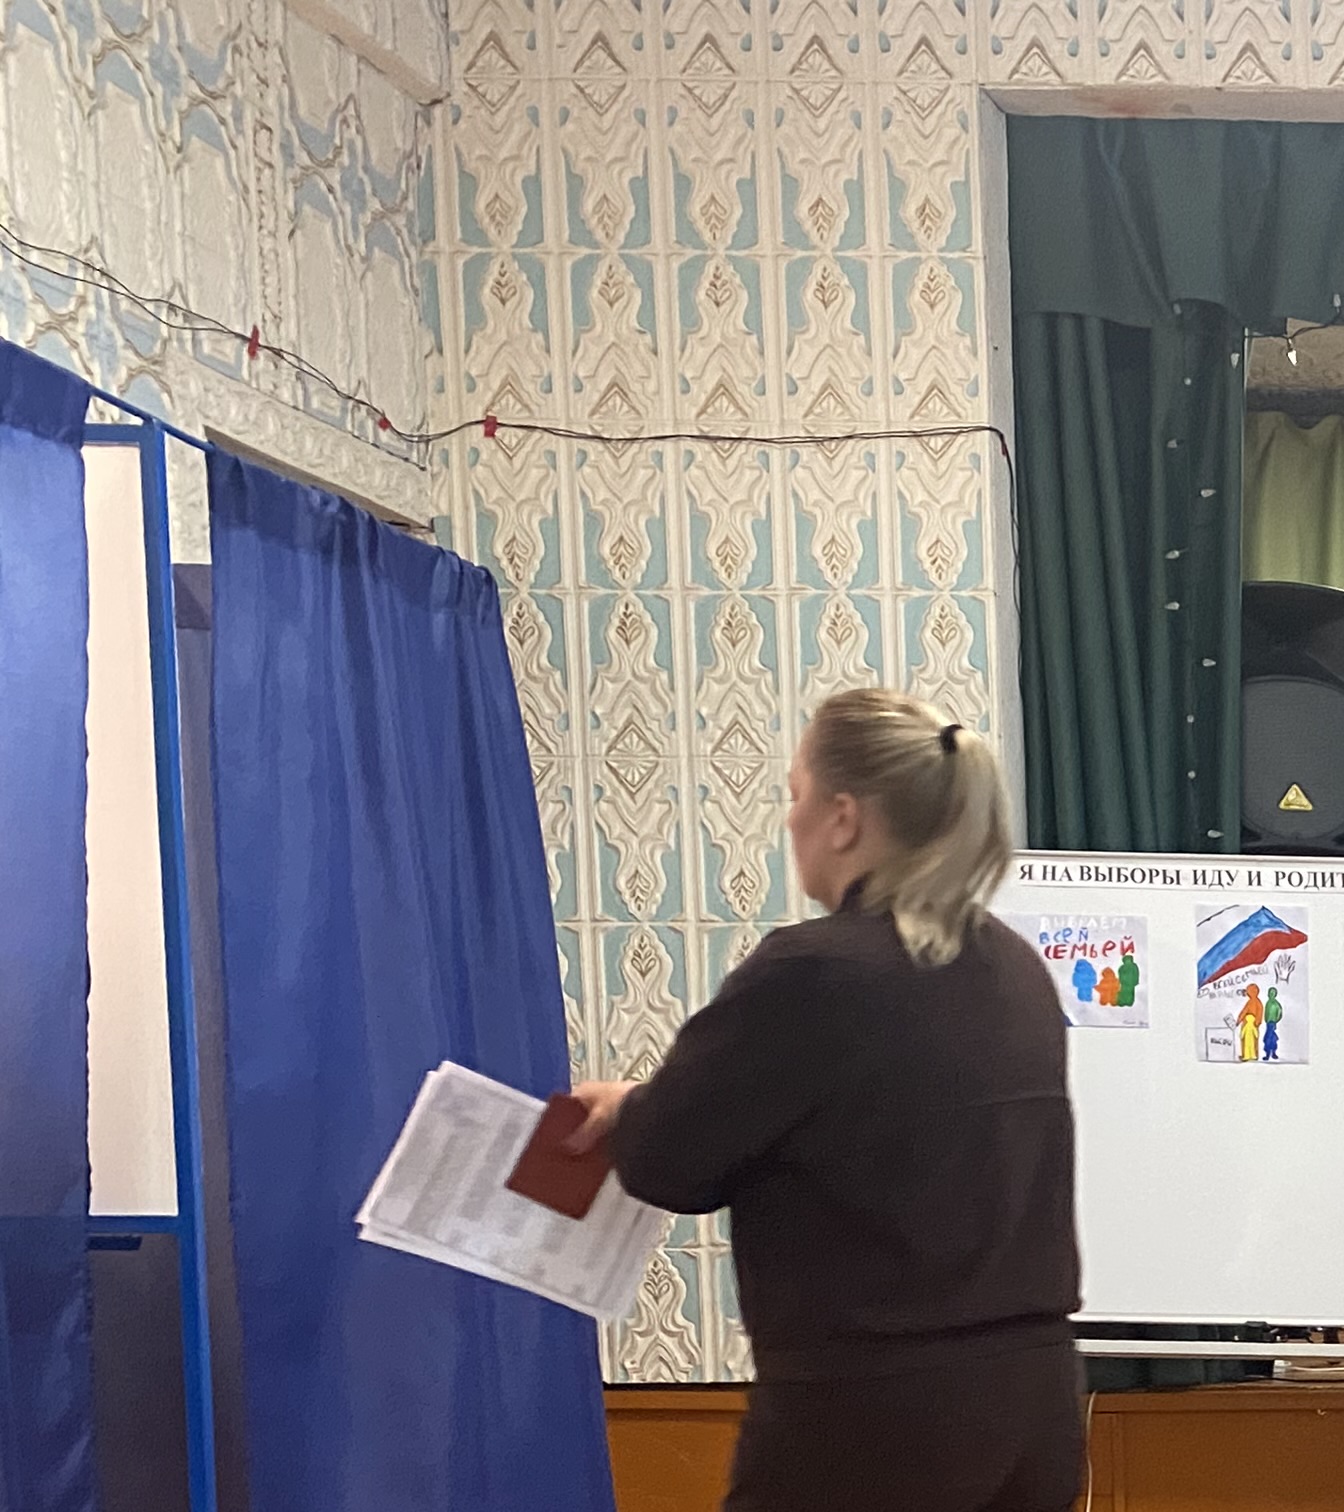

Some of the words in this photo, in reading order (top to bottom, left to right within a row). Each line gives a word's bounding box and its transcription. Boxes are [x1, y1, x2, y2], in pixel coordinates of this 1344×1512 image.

[1019, 864, 1033, 880] Я
[1042, 865, 1073, 882] НА
[1080, 865, 1182, 886] ВЫБОРЫ
[1192, 869, 1239, 889] ИДУ
[1247, 870, 1262, 887] И
[1044, 935, 1135, 960] СЕМЬЕЙ
